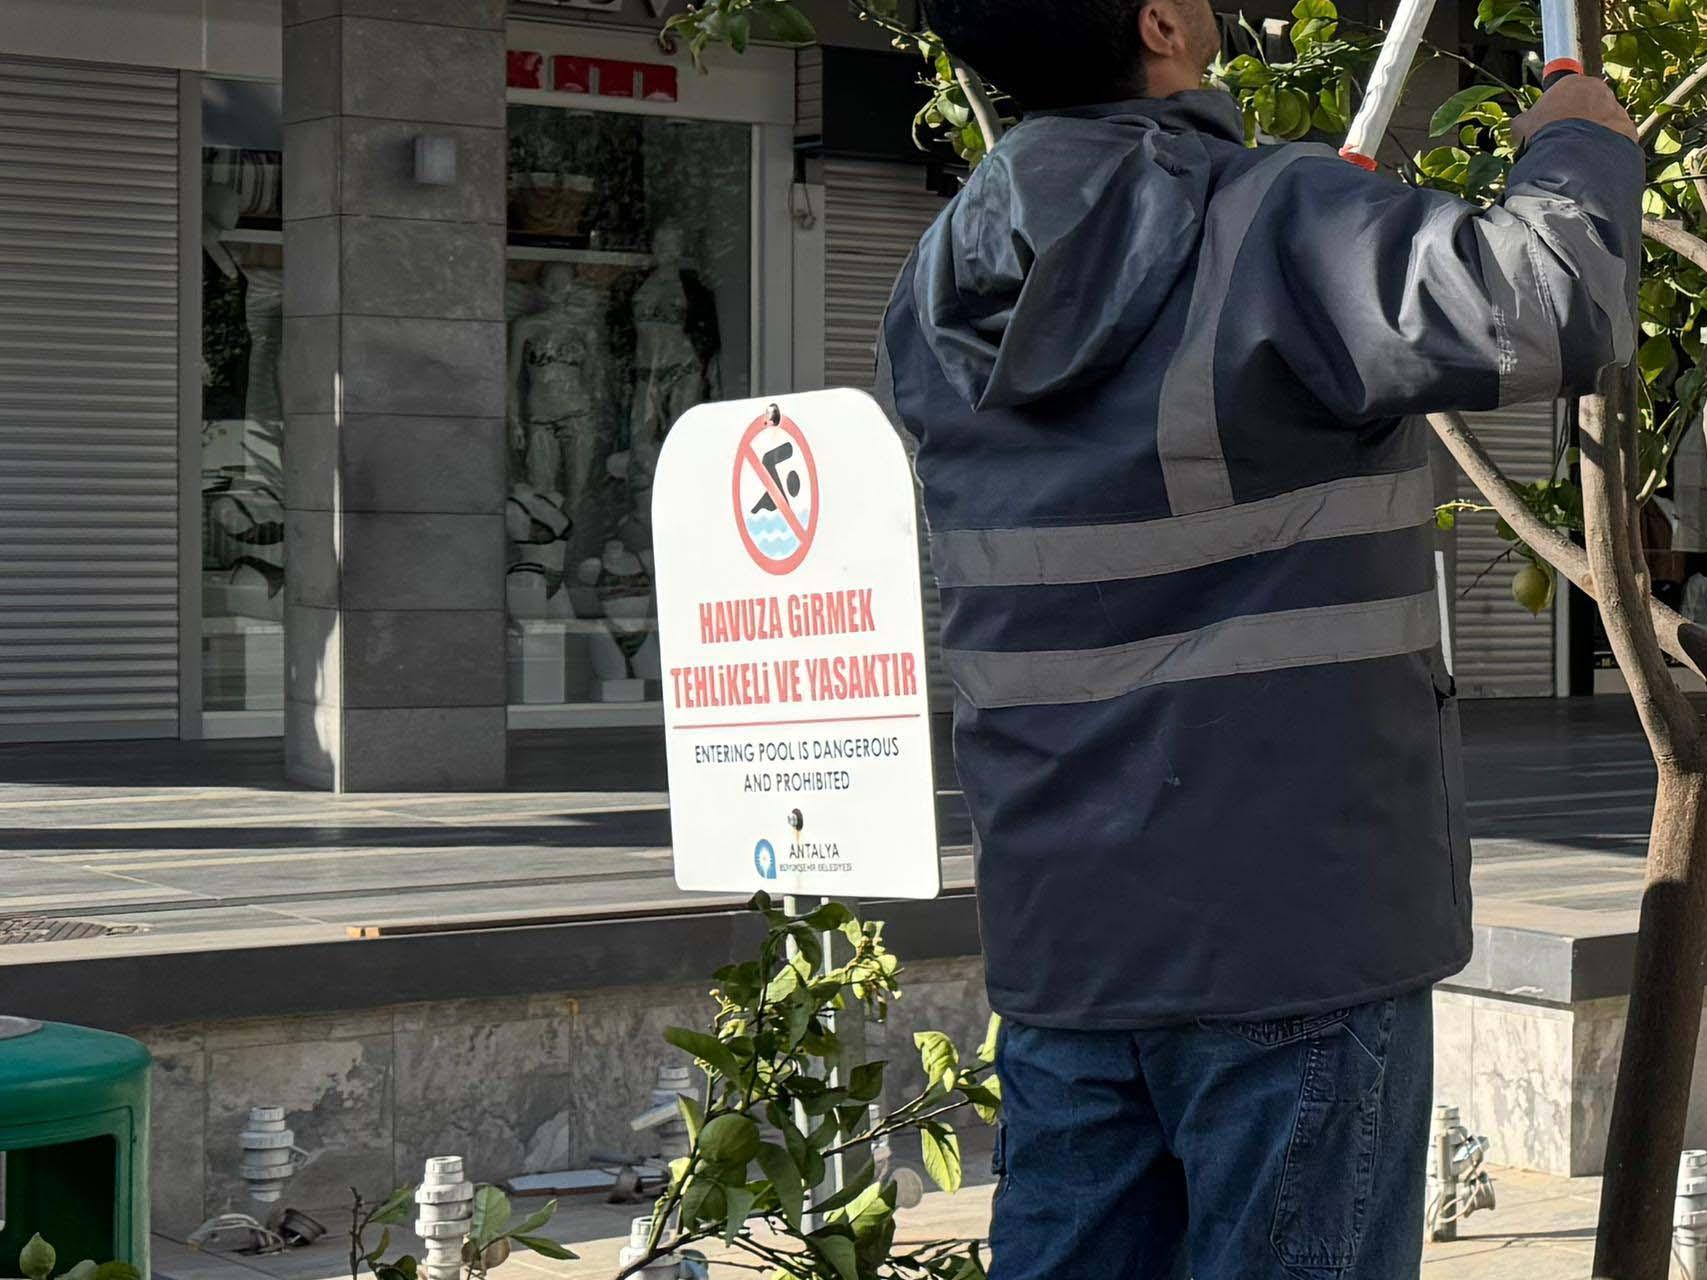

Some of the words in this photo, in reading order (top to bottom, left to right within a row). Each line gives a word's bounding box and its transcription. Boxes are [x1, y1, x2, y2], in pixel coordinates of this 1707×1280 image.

[699, 597, 783, 644] HAVUZA
[774, 660, 802, 703] VE
[805, 652, 917, 702] YASAKTIR
[695, 743, 755, 763] ENTERING
[758, 742, 795, 762] POOL
[798, 741, 809, 760] IS
[813, 737, 900, 759] DANGEROUS
[744, 773, 772, 793] AND
[776, 771, 850, 792] PROHIBITED
[789, 843, 840, 859] ANTALYA
